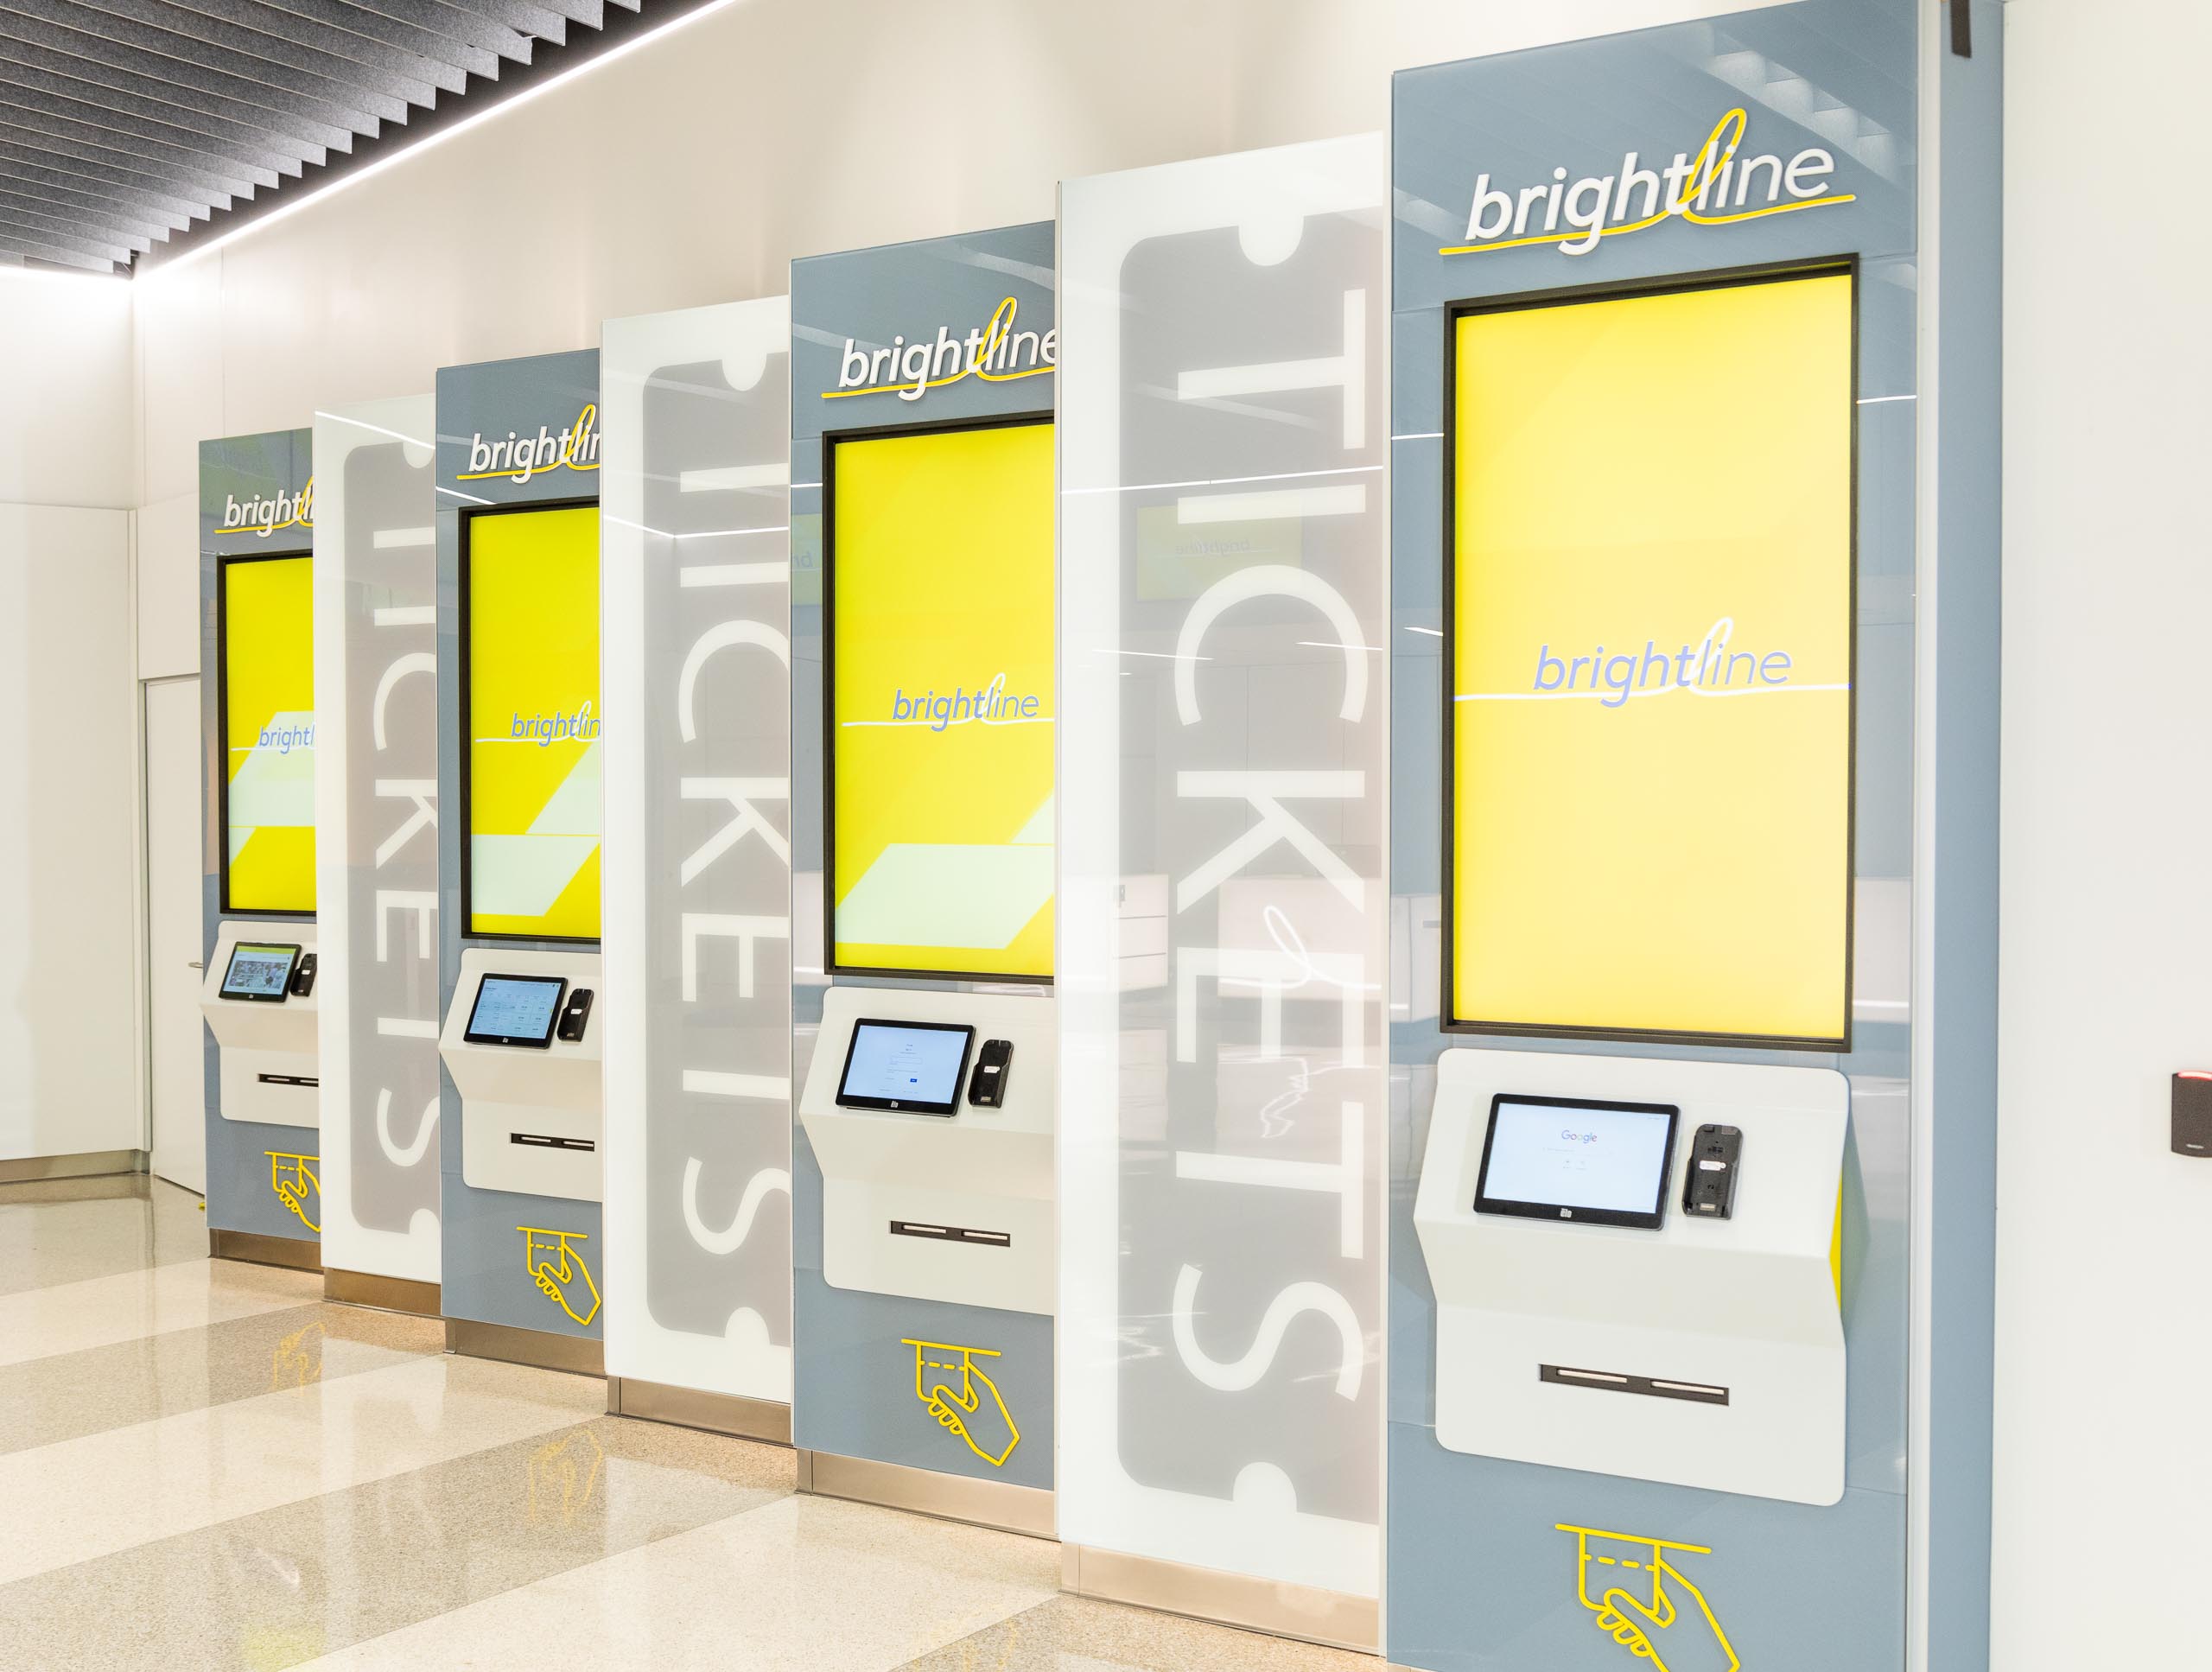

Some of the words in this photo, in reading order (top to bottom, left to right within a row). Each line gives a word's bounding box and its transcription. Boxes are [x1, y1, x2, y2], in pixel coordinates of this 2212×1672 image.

[1463, 108, 1836, 256] brightline
[892, 673, 1039, 732] brightline
[1532, 616, 1792, 709] brightline
[1173, 288, 1368, 1402] TICKETS
[1561, 1129, 1597, 1144] Google
